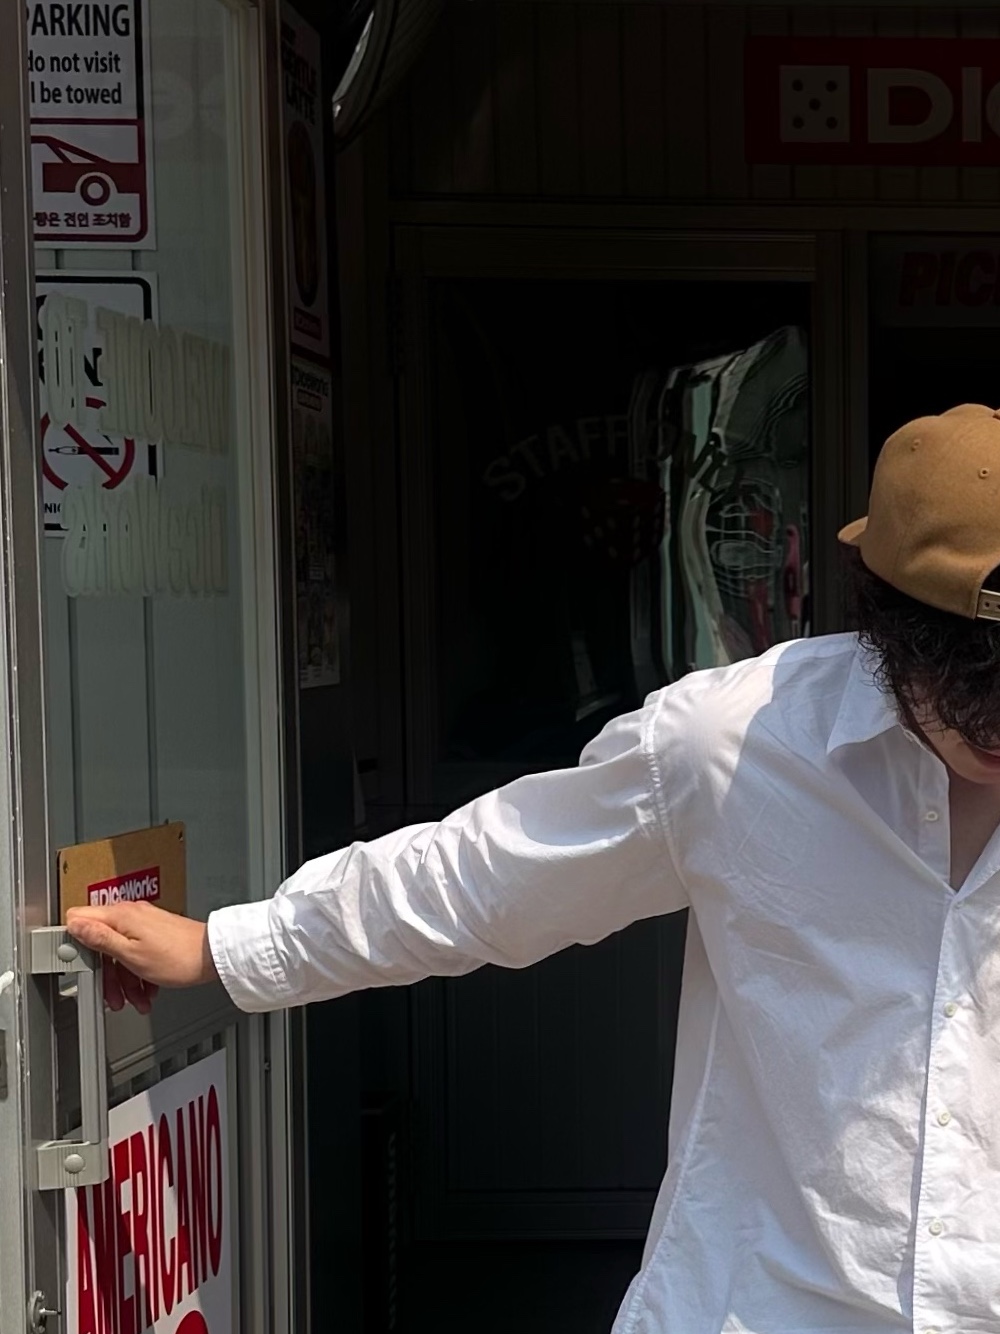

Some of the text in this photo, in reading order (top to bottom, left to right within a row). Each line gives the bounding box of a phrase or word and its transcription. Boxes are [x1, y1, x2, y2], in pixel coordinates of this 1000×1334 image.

[27, 4, 130, 37] ARKING
[50, 53, 79, 73] not
[84, 51, 121, 73] visit
[40, 81, 62, 103] be
[67, 82, 122, 104] towed
[33, 211, 60, 227] 량은
[64, 212, 89, 228] 견인
[481, 412, 630, 504] STAFF
